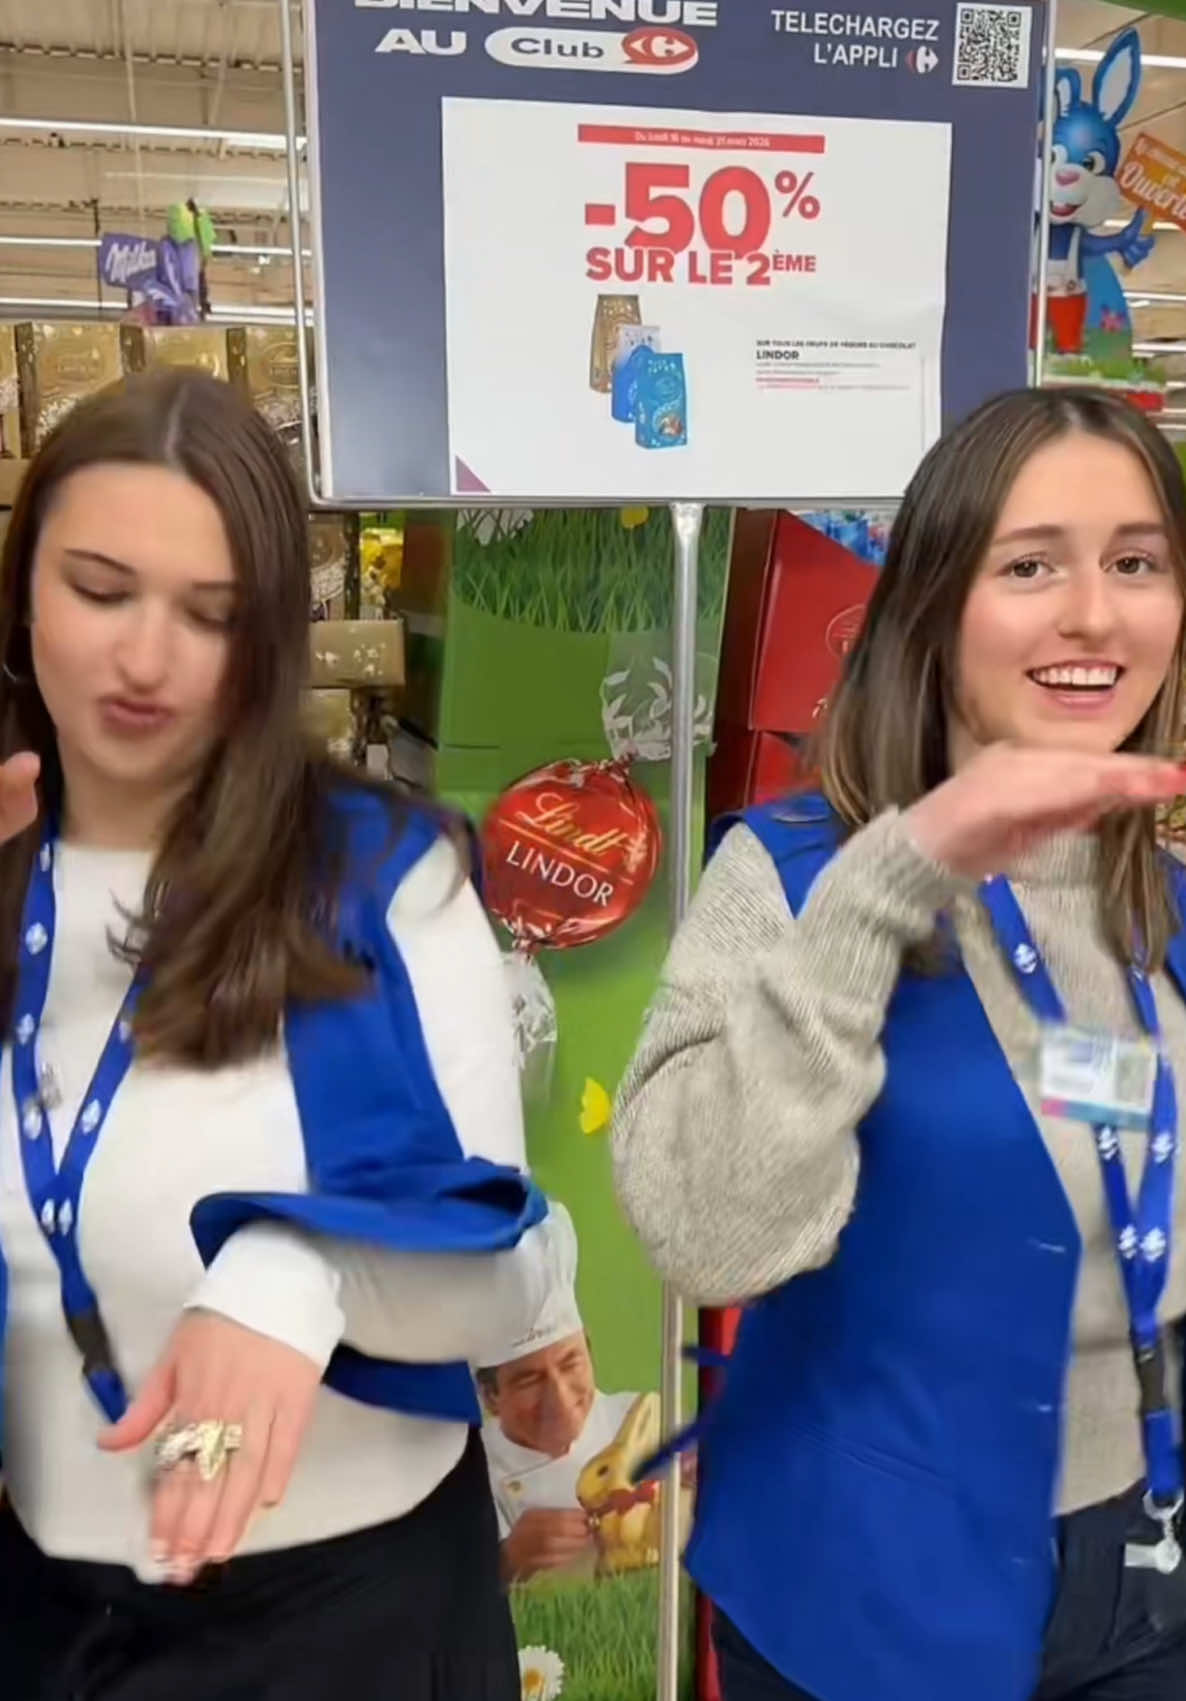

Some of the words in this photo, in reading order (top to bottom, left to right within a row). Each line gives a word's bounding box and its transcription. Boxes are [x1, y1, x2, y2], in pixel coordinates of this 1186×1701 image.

[375, 28, 467, 55] AU
[511, 37, 604, 58] Club
[771, 9, 939, 41] TELECHARGEZ
[814, 43, 898, 68] L'APPLI
[585, 162, 820, 259] -50%
[105, 241, 157, 283] Milka
[586, 247, 675, 282] SUR
[689, 250, 733, 285] LE
[747, 249, 817, 285] 2ÈME
[756, 351, 800, 360] LINDOR
[515, 792, 628, 855] Lindt
[506, 840, 614, 907] LINDOR
